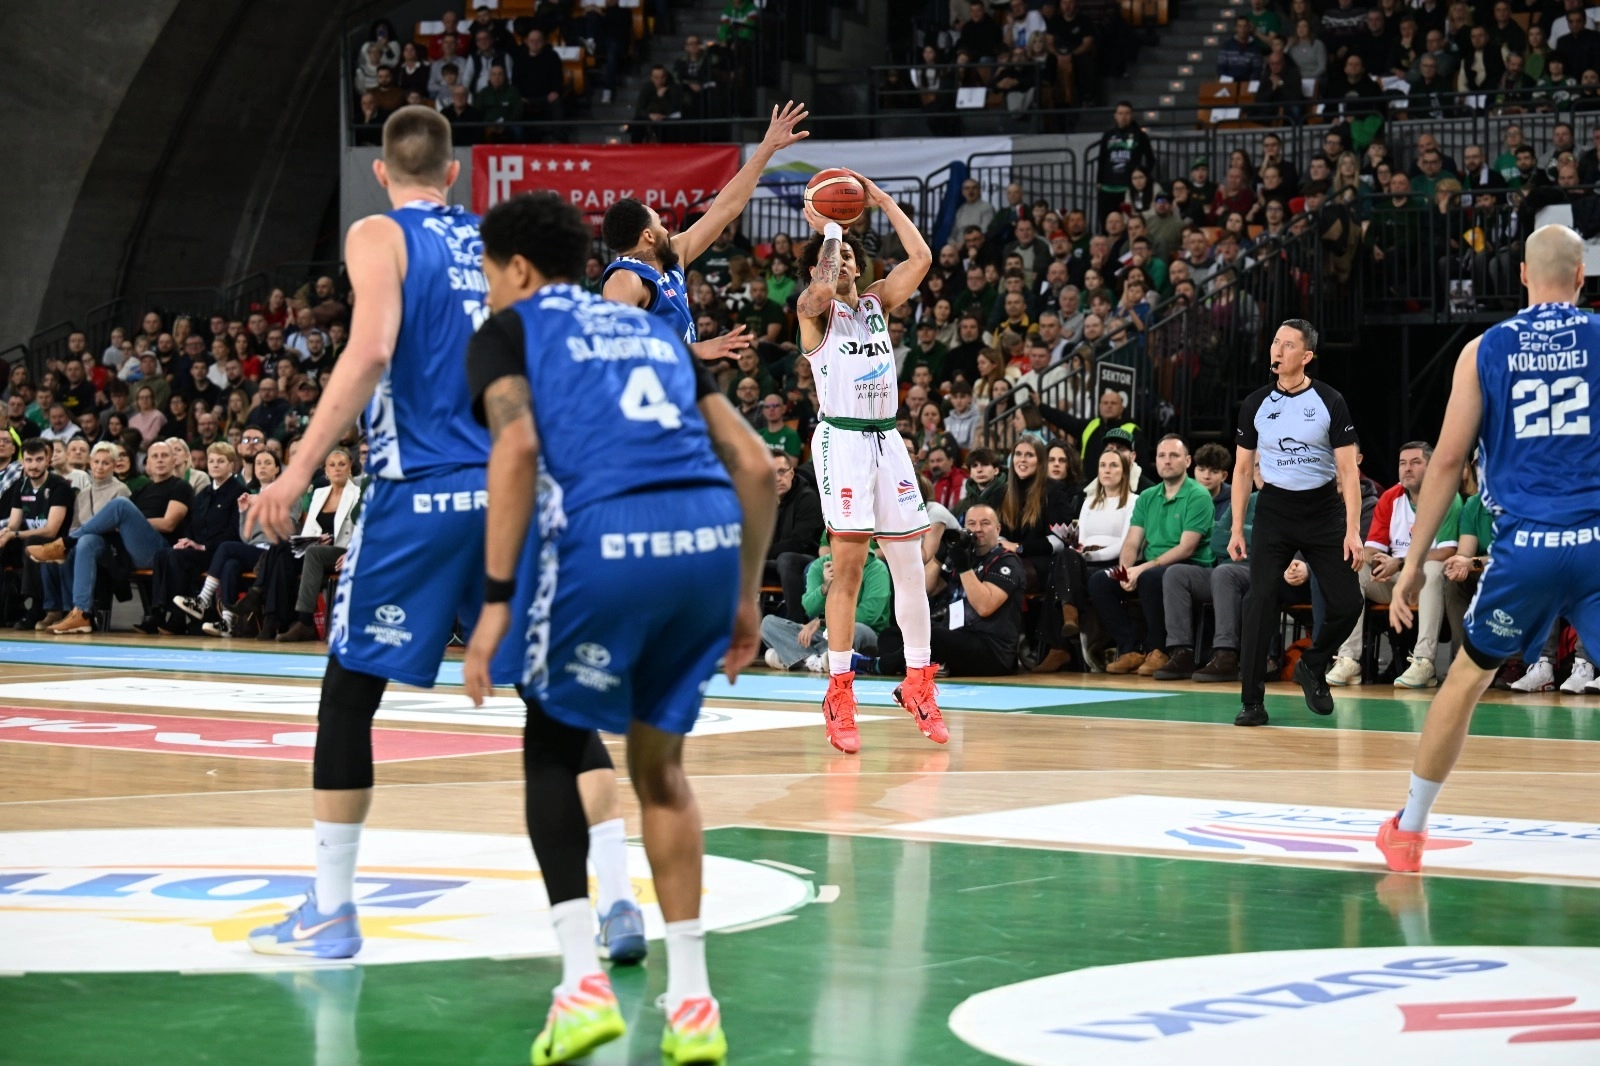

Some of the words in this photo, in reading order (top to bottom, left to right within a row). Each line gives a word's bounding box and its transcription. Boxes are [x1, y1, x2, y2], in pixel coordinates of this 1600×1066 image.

[1532, 315, 1588, 332] ORLEN
[1519, 331, 1550, 341] pre
[1520, 341, 1562, 352] zero
[1507, 349, 1588, 372] KOŁODZIEJ
[1101, 368, 1132, 385] SEKTOR
[620, 365, 683, 430] 4
[1267, 411, 1281, 420] 4F
[1511, 375, 1591, 439] 22
[1277, 457, 1297, 467] Bank
[1395, 539, 1410, 547] Euro
[1044, 957, 1508, 1042] SUZUKI
